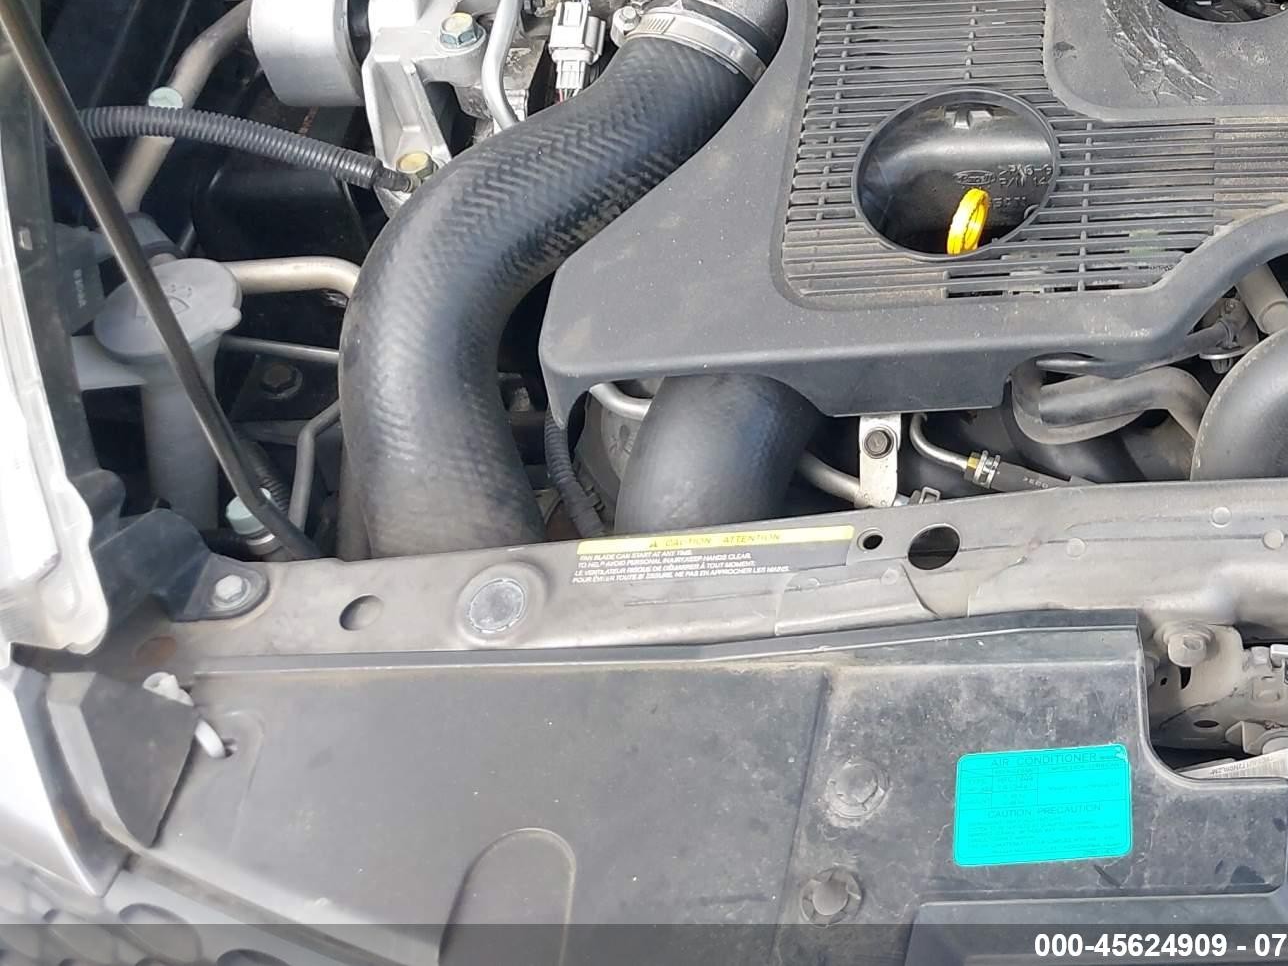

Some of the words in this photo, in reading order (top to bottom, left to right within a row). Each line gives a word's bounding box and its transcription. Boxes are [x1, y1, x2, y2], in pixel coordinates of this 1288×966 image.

[722, 533, 781, 544] ATTENTION
[991, 758, 1010, 767] AIR
[1016, 752, 1097, 765] CONDITIONER
[987, 808, 1033, 819] CAUTION
